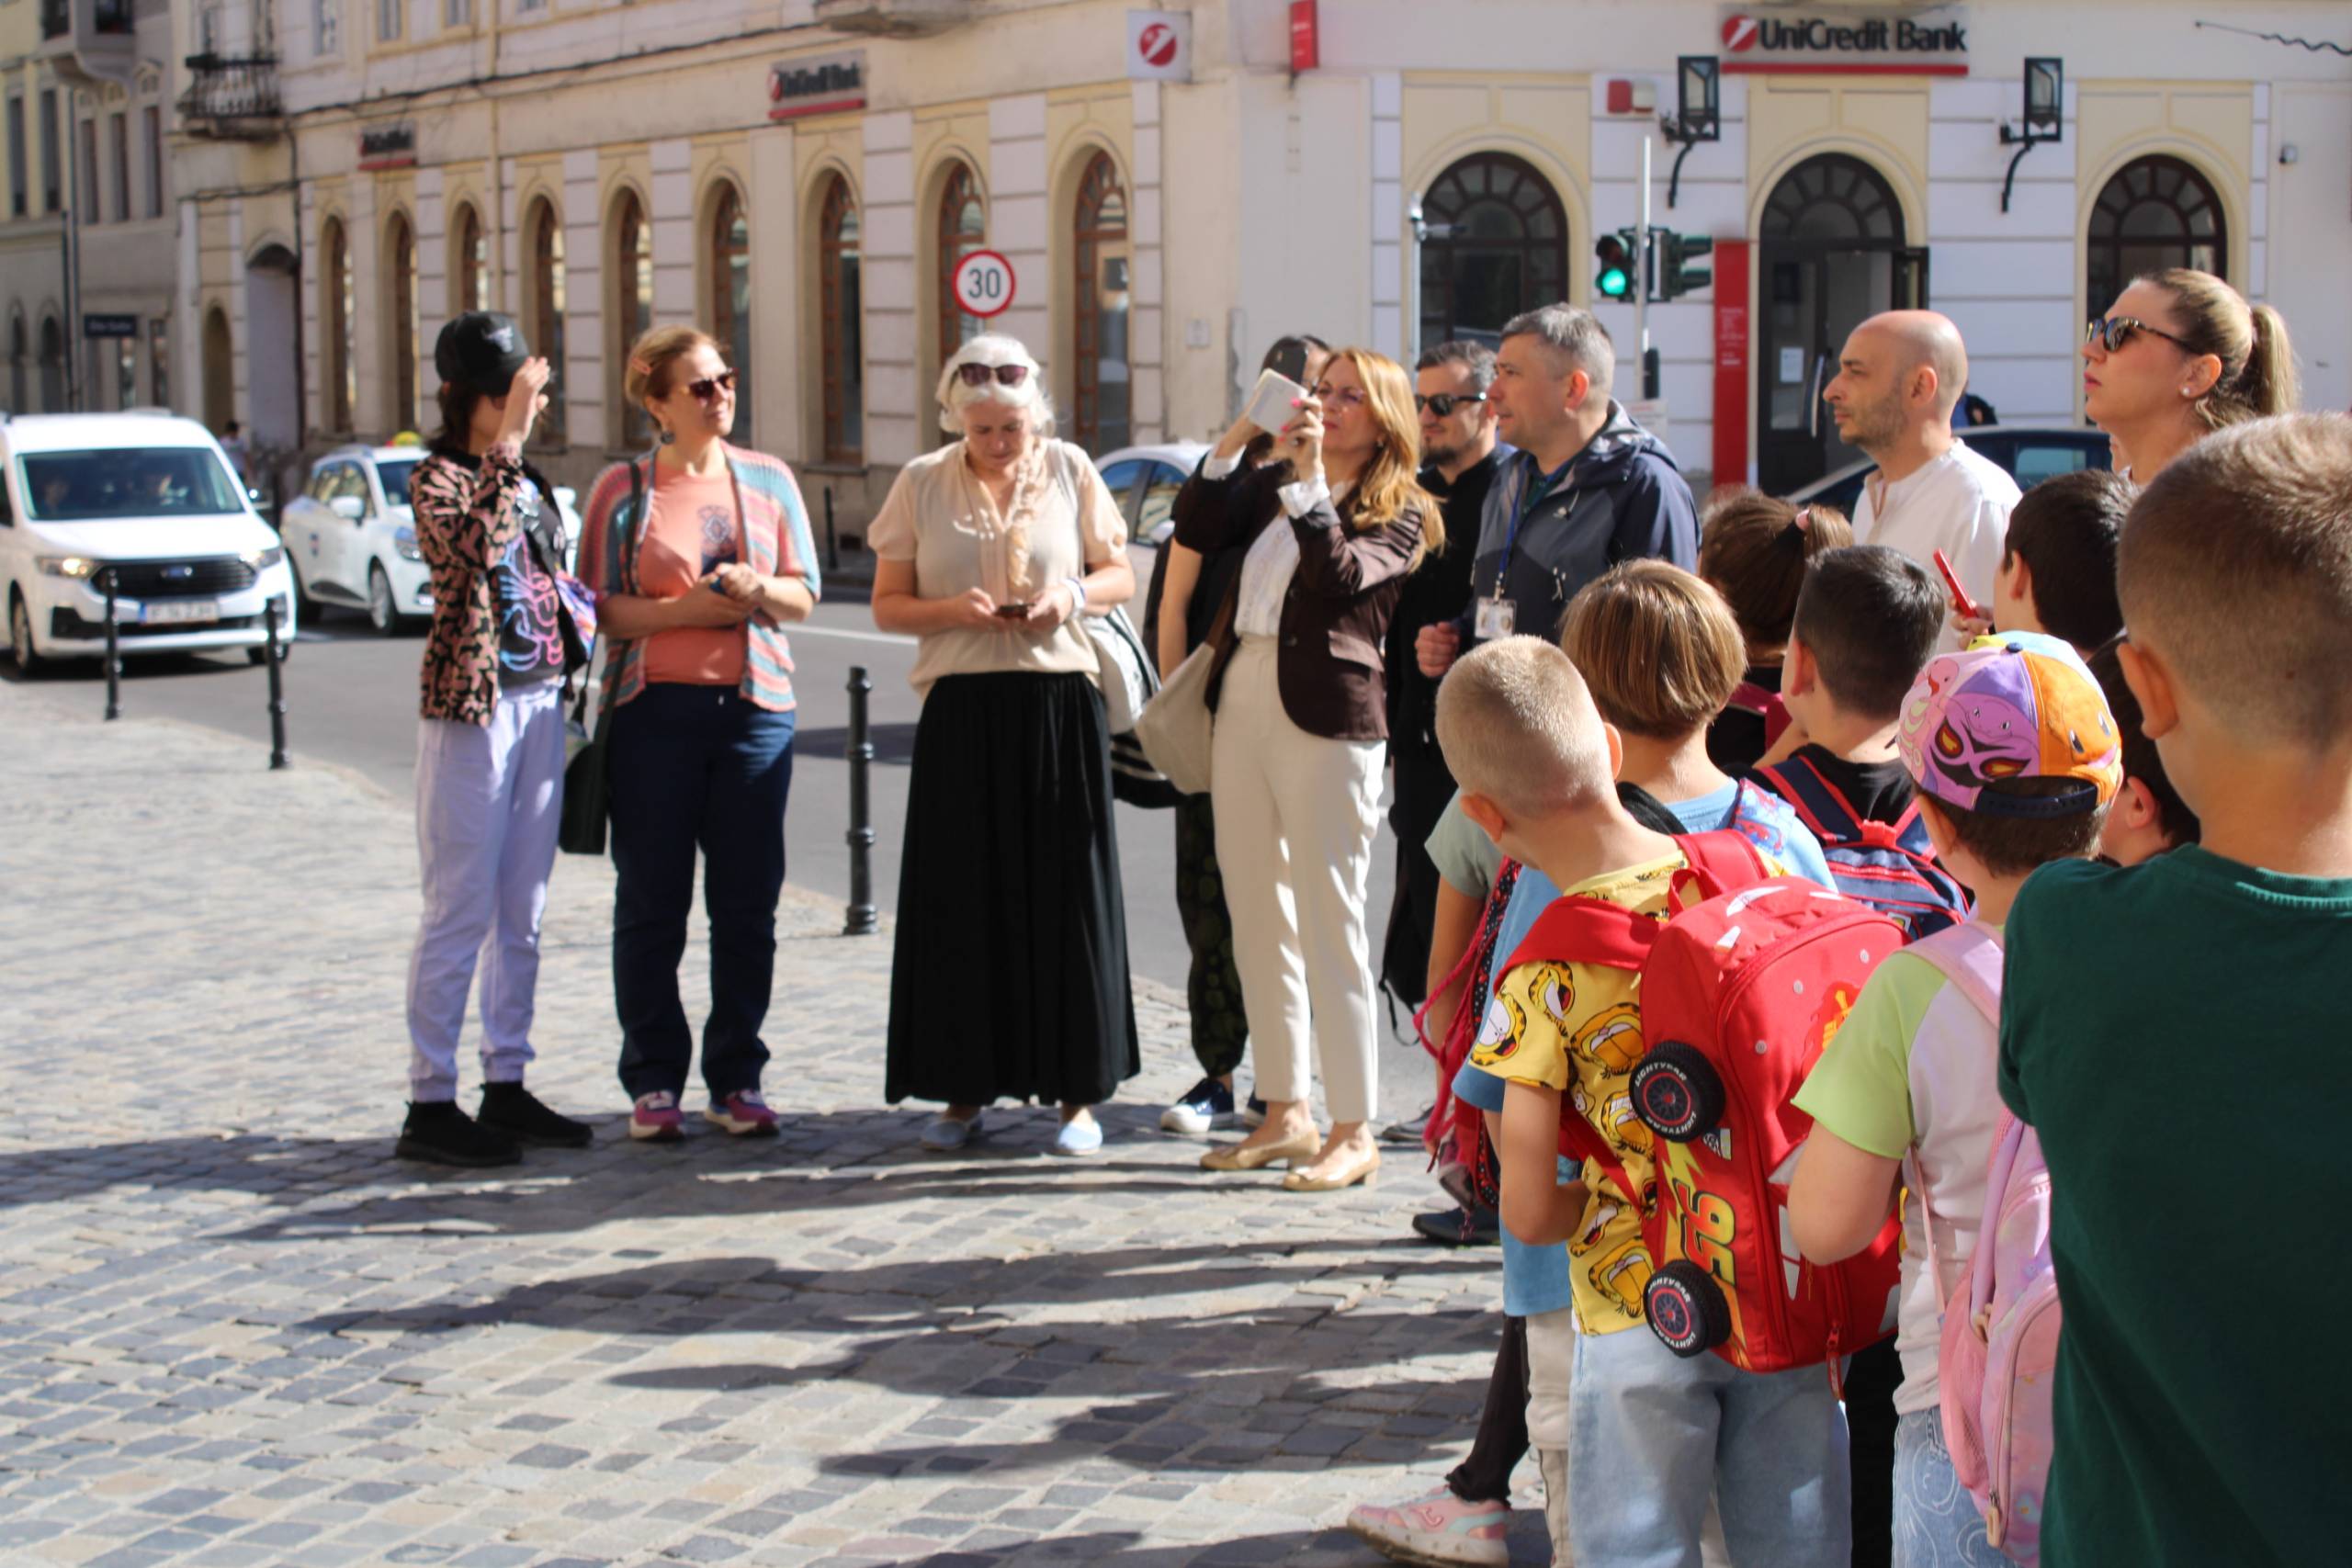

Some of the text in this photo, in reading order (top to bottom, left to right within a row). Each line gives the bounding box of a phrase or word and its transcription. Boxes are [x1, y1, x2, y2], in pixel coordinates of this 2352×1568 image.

[1759, 19, 1966, 51] UniCredit Bank
[967, 267, 1001, 299] 30
[1634, 1061, 1688, 1088] LIGHTYEAR
[1672, 1179, 1736, 1286] 95
